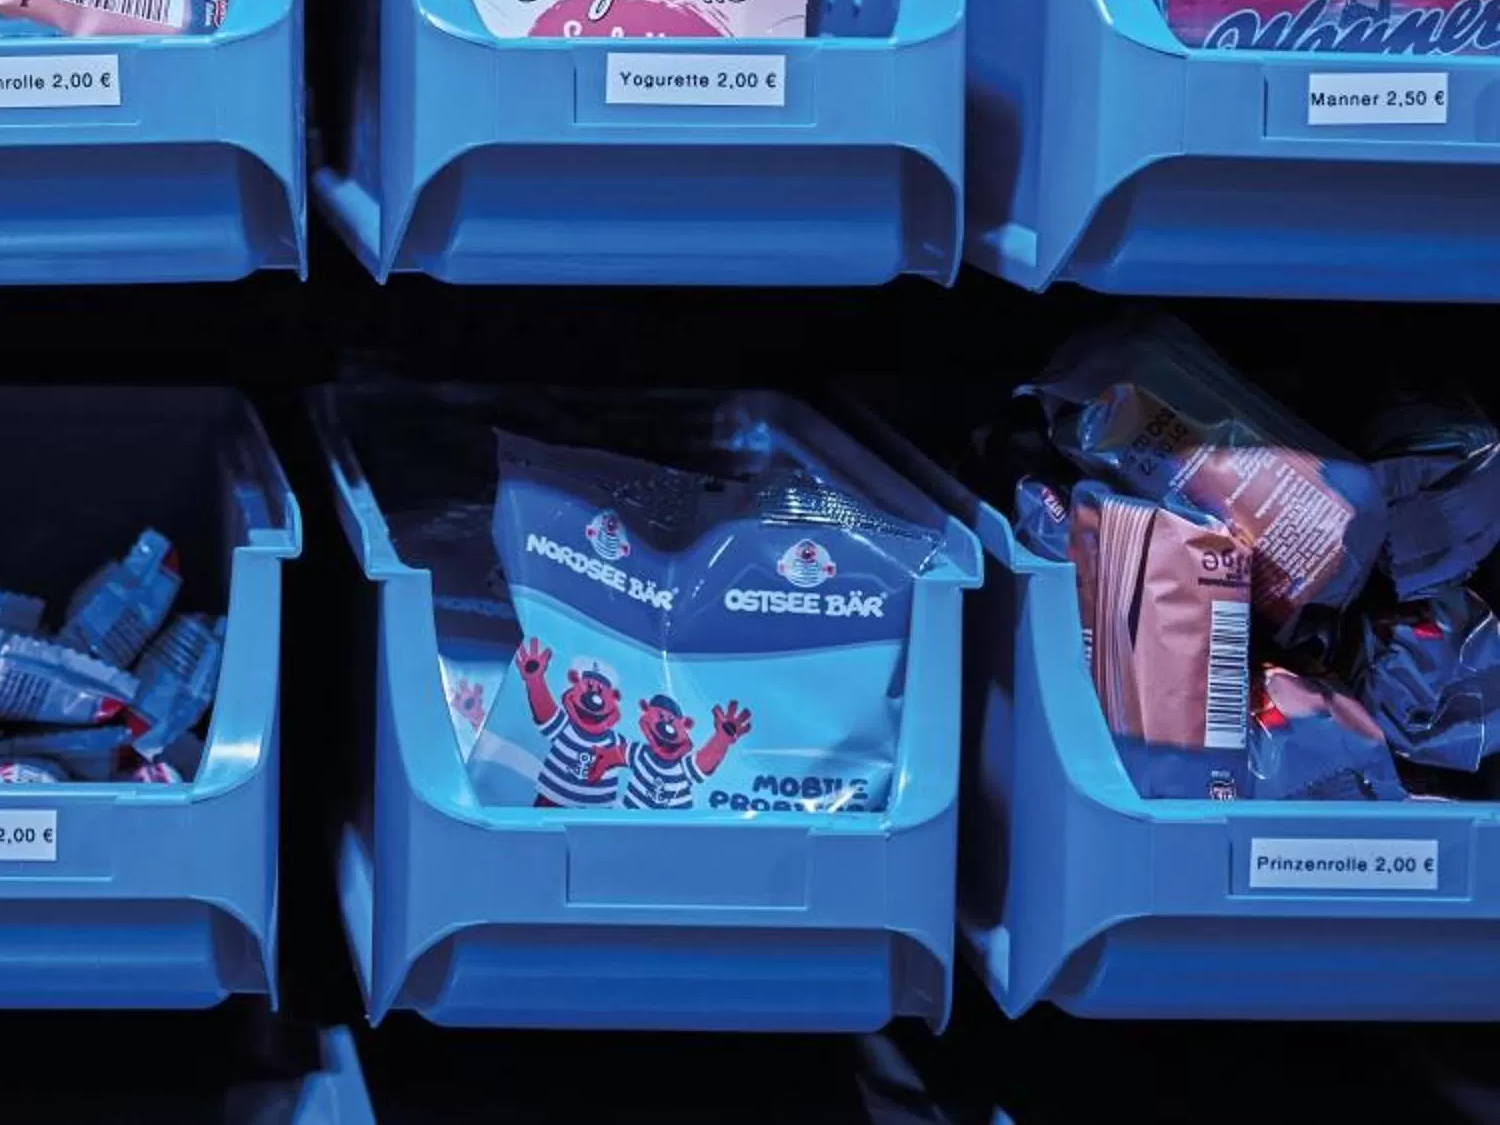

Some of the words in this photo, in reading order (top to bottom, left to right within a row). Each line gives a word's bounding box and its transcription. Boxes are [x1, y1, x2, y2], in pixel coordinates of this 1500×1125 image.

[52, 72, 93, 90] 2,00
[99, 72, 111, 88] €
[619, 71, 710, 89] Yogurette
[717, 72, 758, 89] 2,00
[765, 72, 777, 88] €
[1311, 92, 1380, 107] Manner
[1386, 90, 1427, 107] 2,50
[1434, 90, 1445, 106] €
[526, 534, 627, 592] NORDSEE
[628, 577, 675, 612] BÄR
[724, 588, 821, 615] OSTSEE
[824, 589, 885, 618] BÄR
[43, 828, 53, 843] €
[1257, 855, 1368, 872] Prinzenrolle
[1375, 857, 1417, 874] 2,00
[1423, 857, 1434, 873] €
